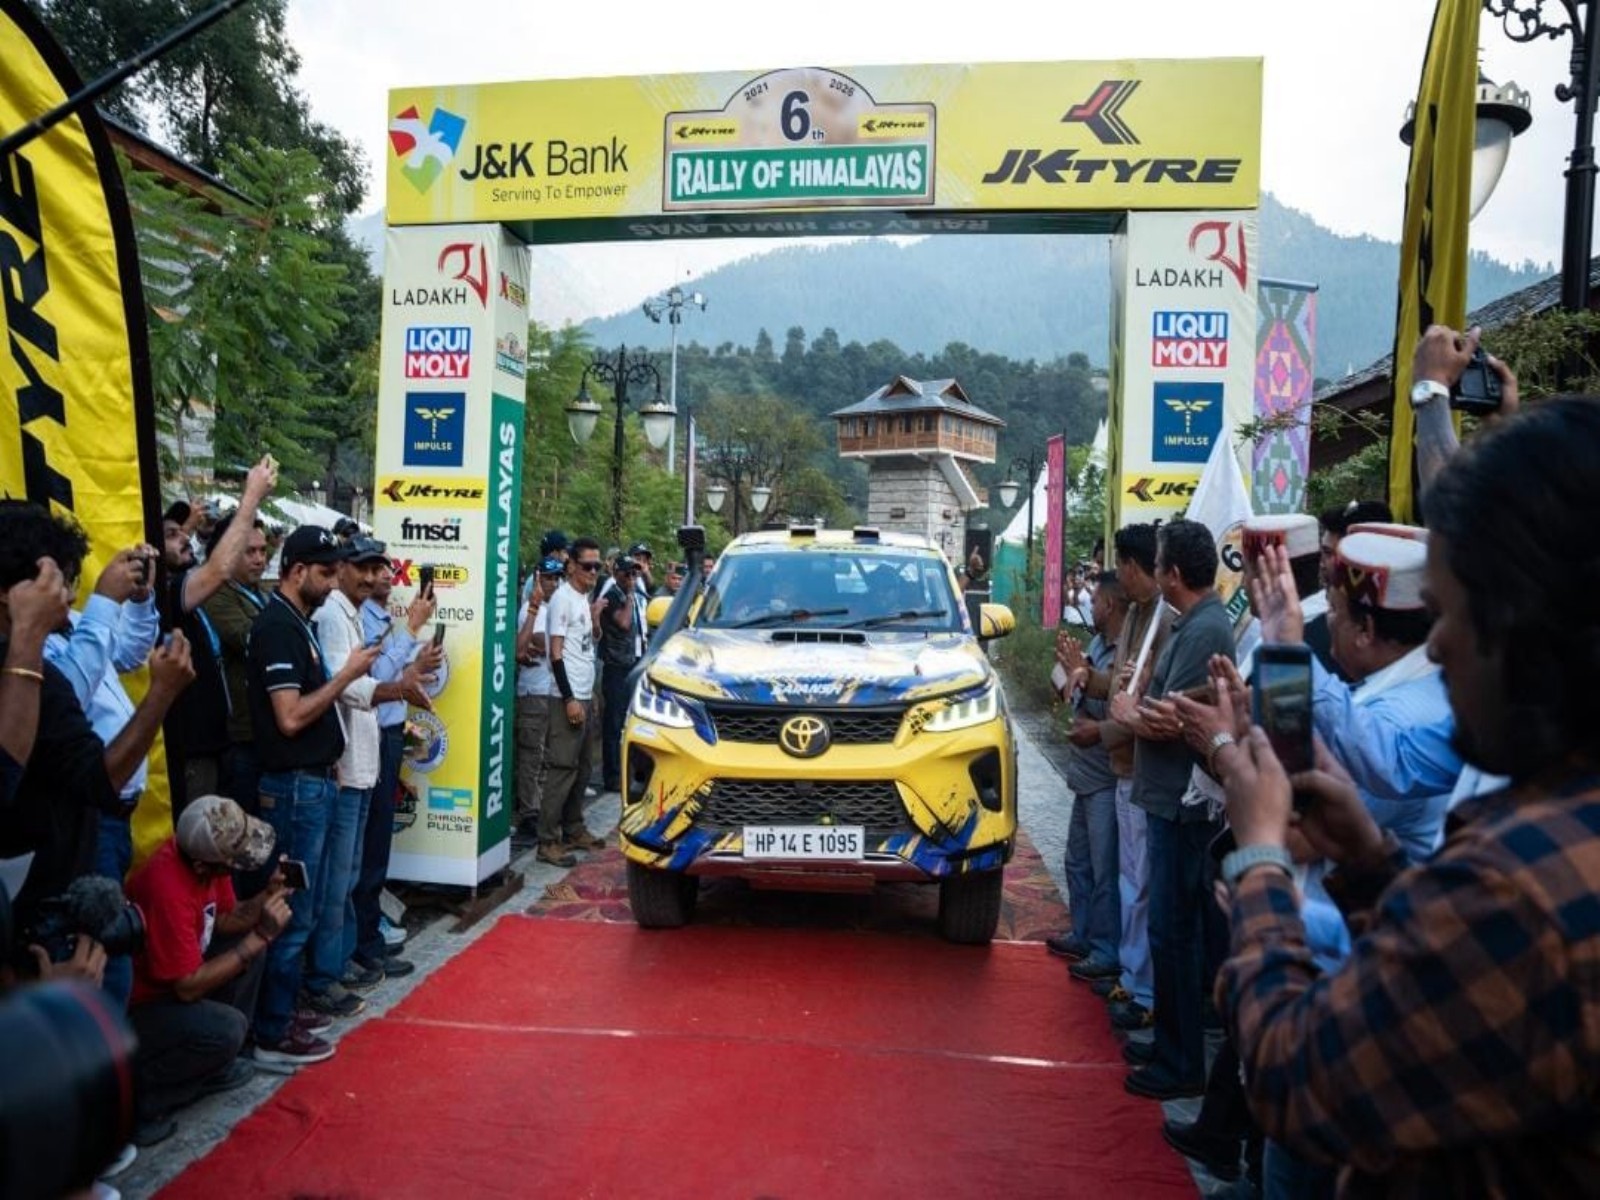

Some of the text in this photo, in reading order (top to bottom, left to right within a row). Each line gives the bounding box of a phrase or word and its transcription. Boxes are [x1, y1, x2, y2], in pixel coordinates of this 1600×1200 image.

[744, 82, 769, 102] 2021
[460, 136, 629, 181] J&K Bank
[676, 150, 922, 197] RALLY OF HIMALAYAS
[492, 184, 629, 204] Serving To Empower
[1136, 268, 1224, 288] LADAKH
[393, 288, 467, 306] LADAKH
[1156, 313, 1225, 338] LIQUI
[409, 329, 468, 352] LIQUI
[1155, 340, 1227, 366] MOLY
[407, 354, 469, 377] MOLY
[414, 442, 452, 451] IMPULSE
[1164, 436, 1210, 446] IMPULSE
[401, 517, 462, 541] fmsci
[1221, 543, 1244, 573] 6
[486, 421, 517, 820] RALLY OF HIMALAYAS
[427, 822, 473, 834] PULSE
[756, 833, 776, 853] HP
[780, 833, 797, 853] 14
[803, 833, 813, 853] E
[819, 833, 857, 854] 1095
